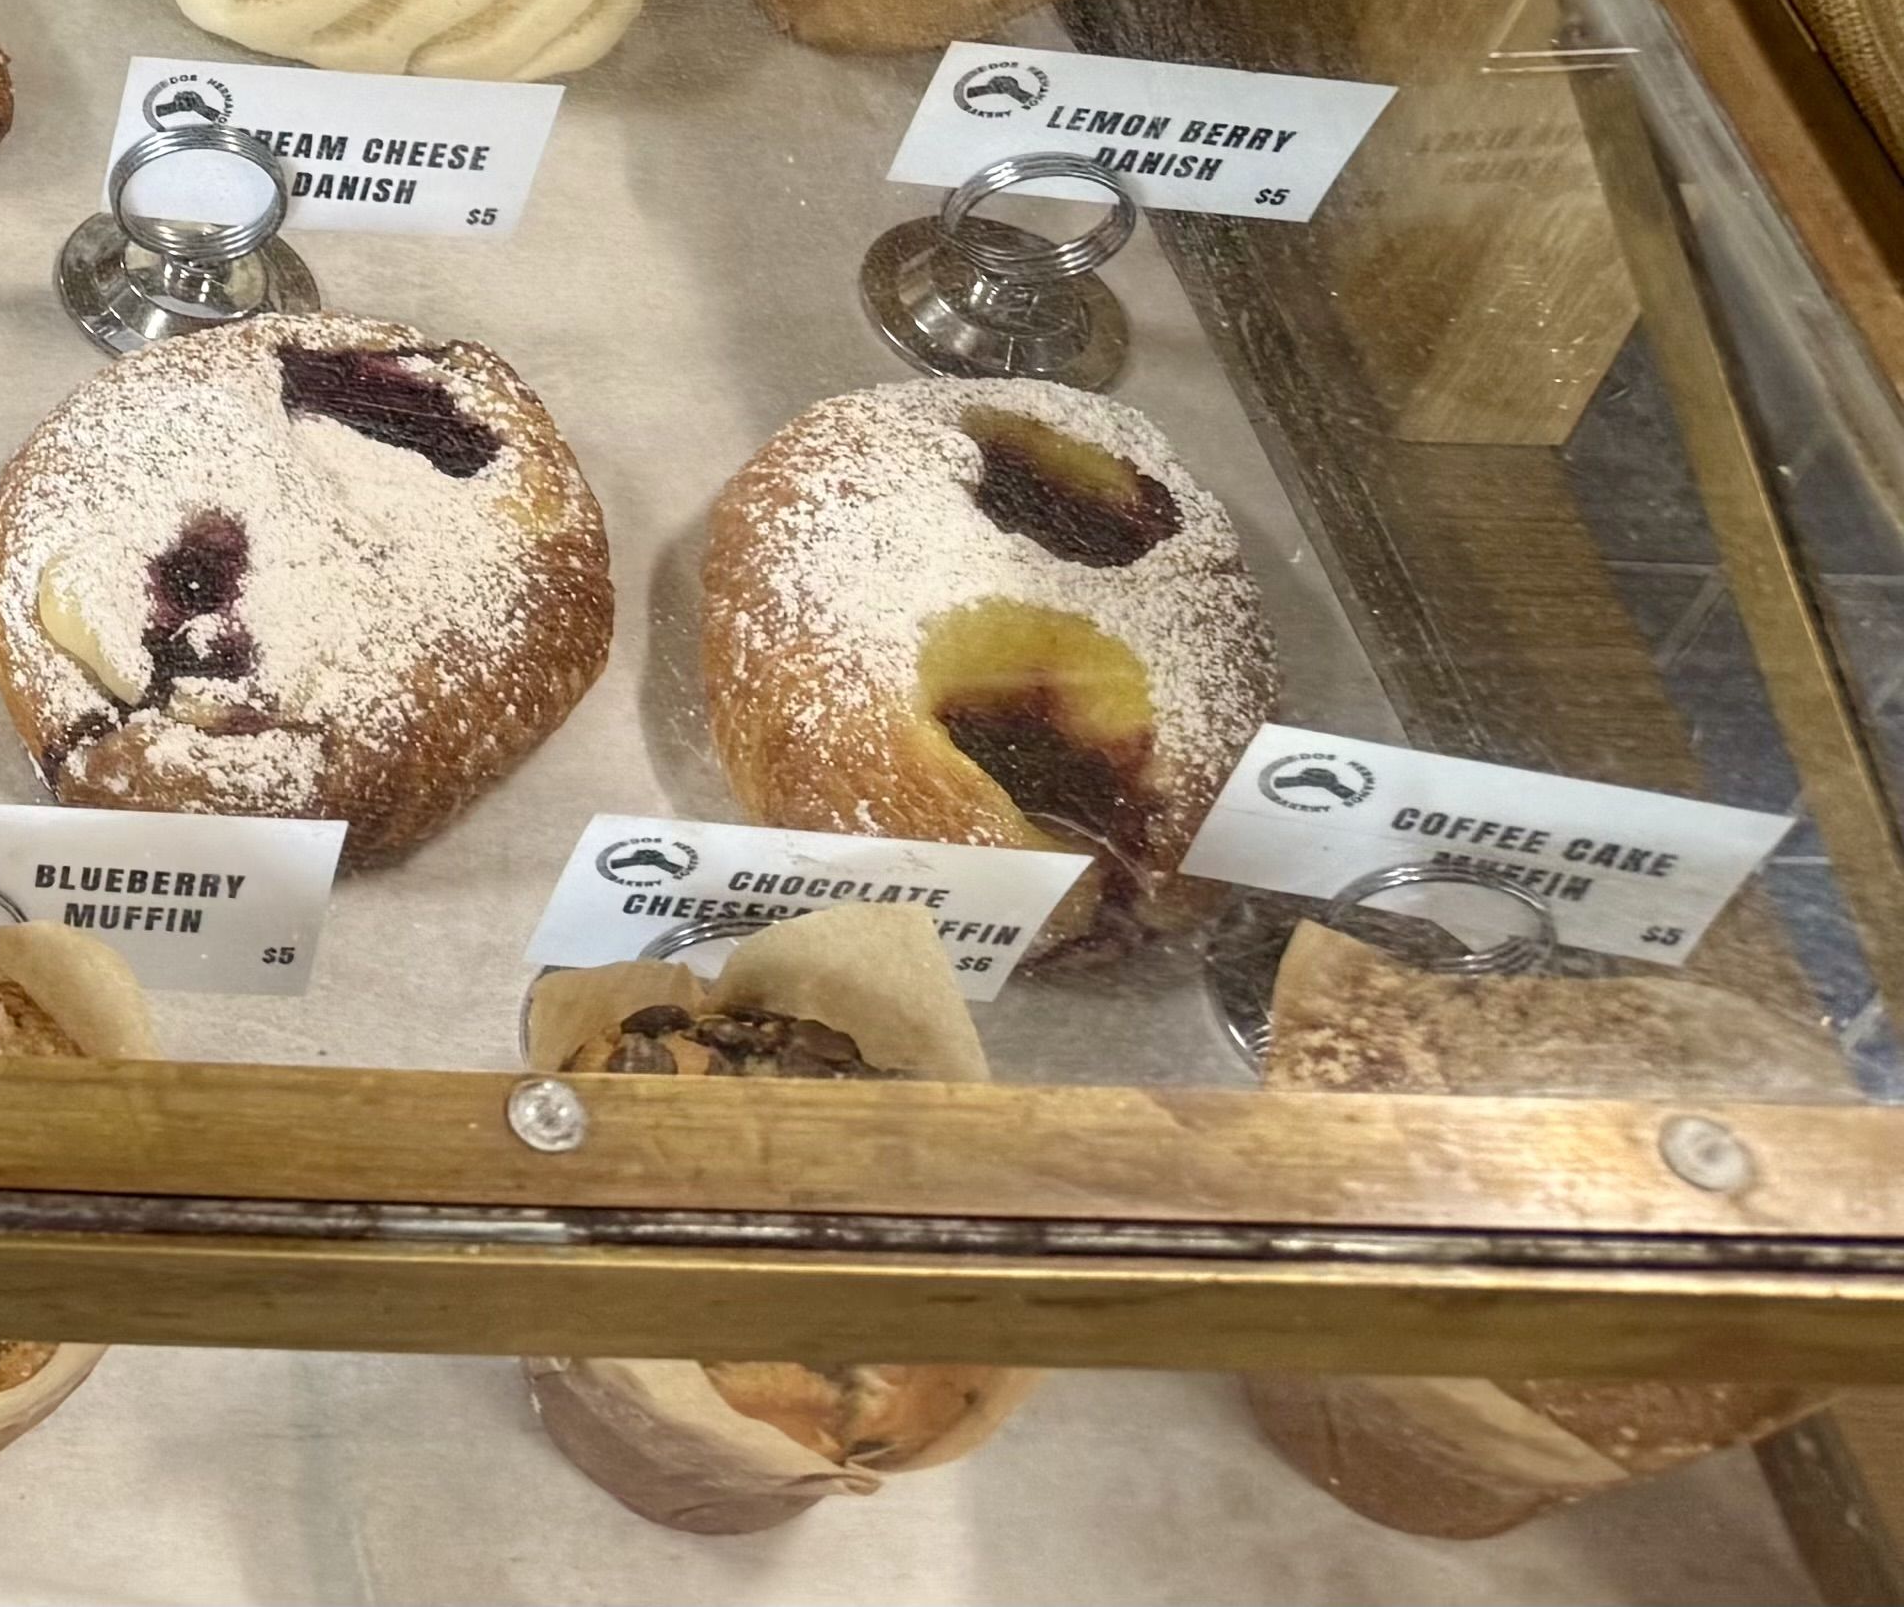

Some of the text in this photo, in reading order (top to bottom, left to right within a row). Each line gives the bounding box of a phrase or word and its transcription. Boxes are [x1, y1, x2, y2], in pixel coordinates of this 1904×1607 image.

[1046, 105, 1297, 154] LEMON BERRY
[237, 127, 490, 172] REAM CHEESE
[1092, 145, 1224, 182] DANISH
[291, 171, 418, 205] DANISH
[1254, 187, 1290, 207] $5
[466, 207, 498, 227] $5
[1391, 806, 1679, 877] COFFEE CAKE
[34, 864, 247, 900] BLUEBERRY
[727, 870, 950, 910] CHOCOLATE
[63, 902, 204, 934] MUFFIN
[622, 893, 1021, 947] CHEESEC FFIN
[1640, 925, 1684, 948] $5
[261, 946, 295, 965] $5
[955, 955, 994, 973] $6
